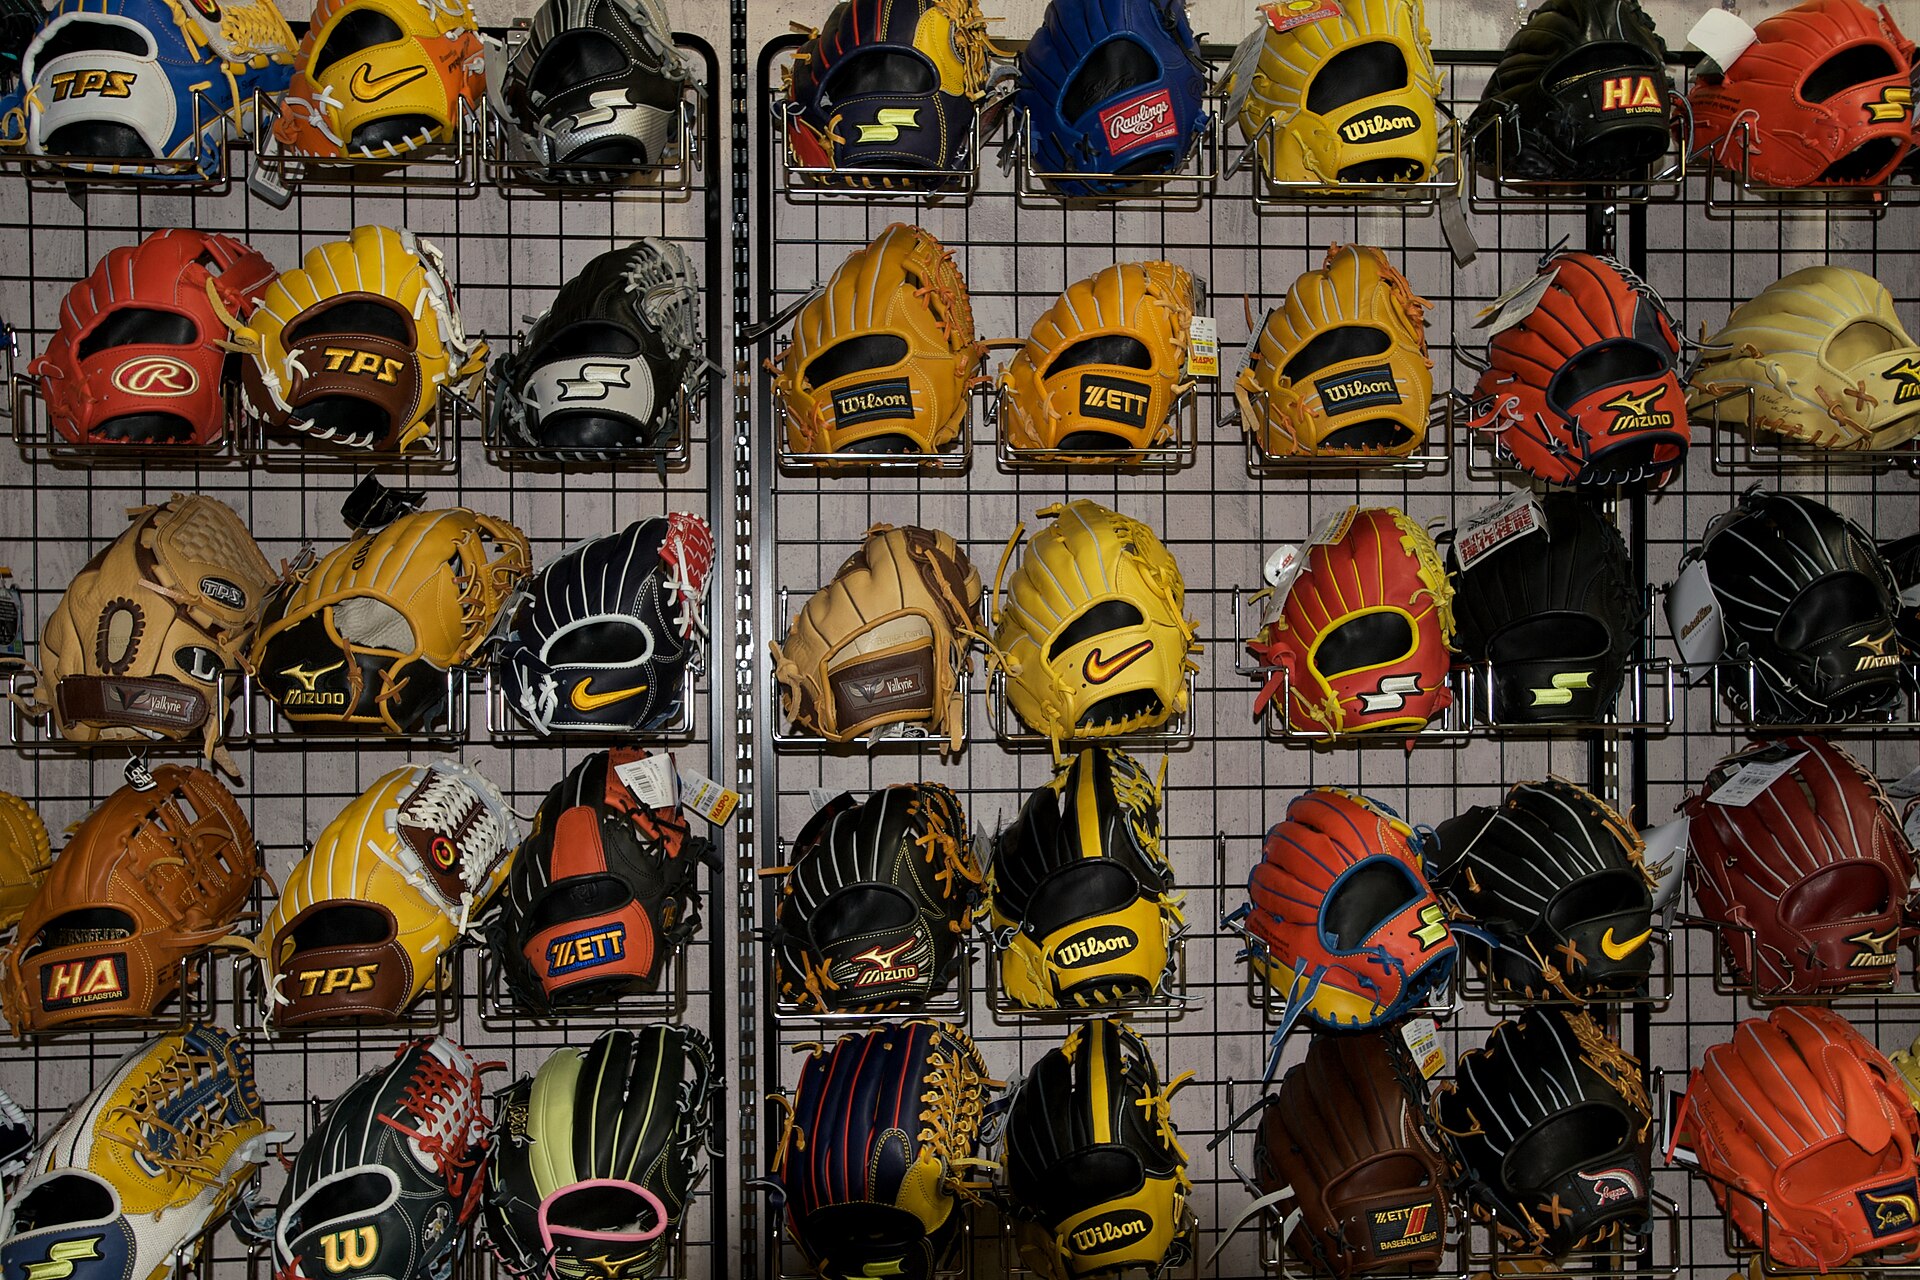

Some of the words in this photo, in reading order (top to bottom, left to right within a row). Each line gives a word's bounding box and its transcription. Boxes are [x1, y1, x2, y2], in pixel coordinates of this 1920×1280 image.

[51, 70, 137, 102] TPS
[1602, 76, 1662, 111] HA
[1110, 101, 1169, 138] Rawlings
[1342, 115, 1416, 142] Wilson
[323, 347, 404, 387] TPS
[838, 392, 909, 413] Wilson
[1084, 385, 1148, 416] ZETT
[1325, 379, 1395, 403] Wilson
[1612, 413, 1672, 431] MIZUNO
[204, 582, 242, 604] TPS
[191, 647, 217, 682] L
[284, 688, 345, 705] MIZUNO
[886, 677, 913, 693] Valkyrie
[149, 695, 181, 714] Valkyrie
[711, 794, 729, 819] HASPO
[550, 930, 624, 969] ZETT
[1058, 935, 1132, 966] Wilson
[47, 957, 122, 1001] HA
[299, 964, 379, 997] TPS
[857, 965, 917, 987] MIZUNO
[1423, 1051, 1440, 1069] ASPO
[1375, 1207, 1411, 1224] ZETT
[1072, 1217, 1148, 1252] Wilson
[1380, 1236, 1420, 1250] BASEBALL
[1420, 1231, 1438, 1242] GEAR
